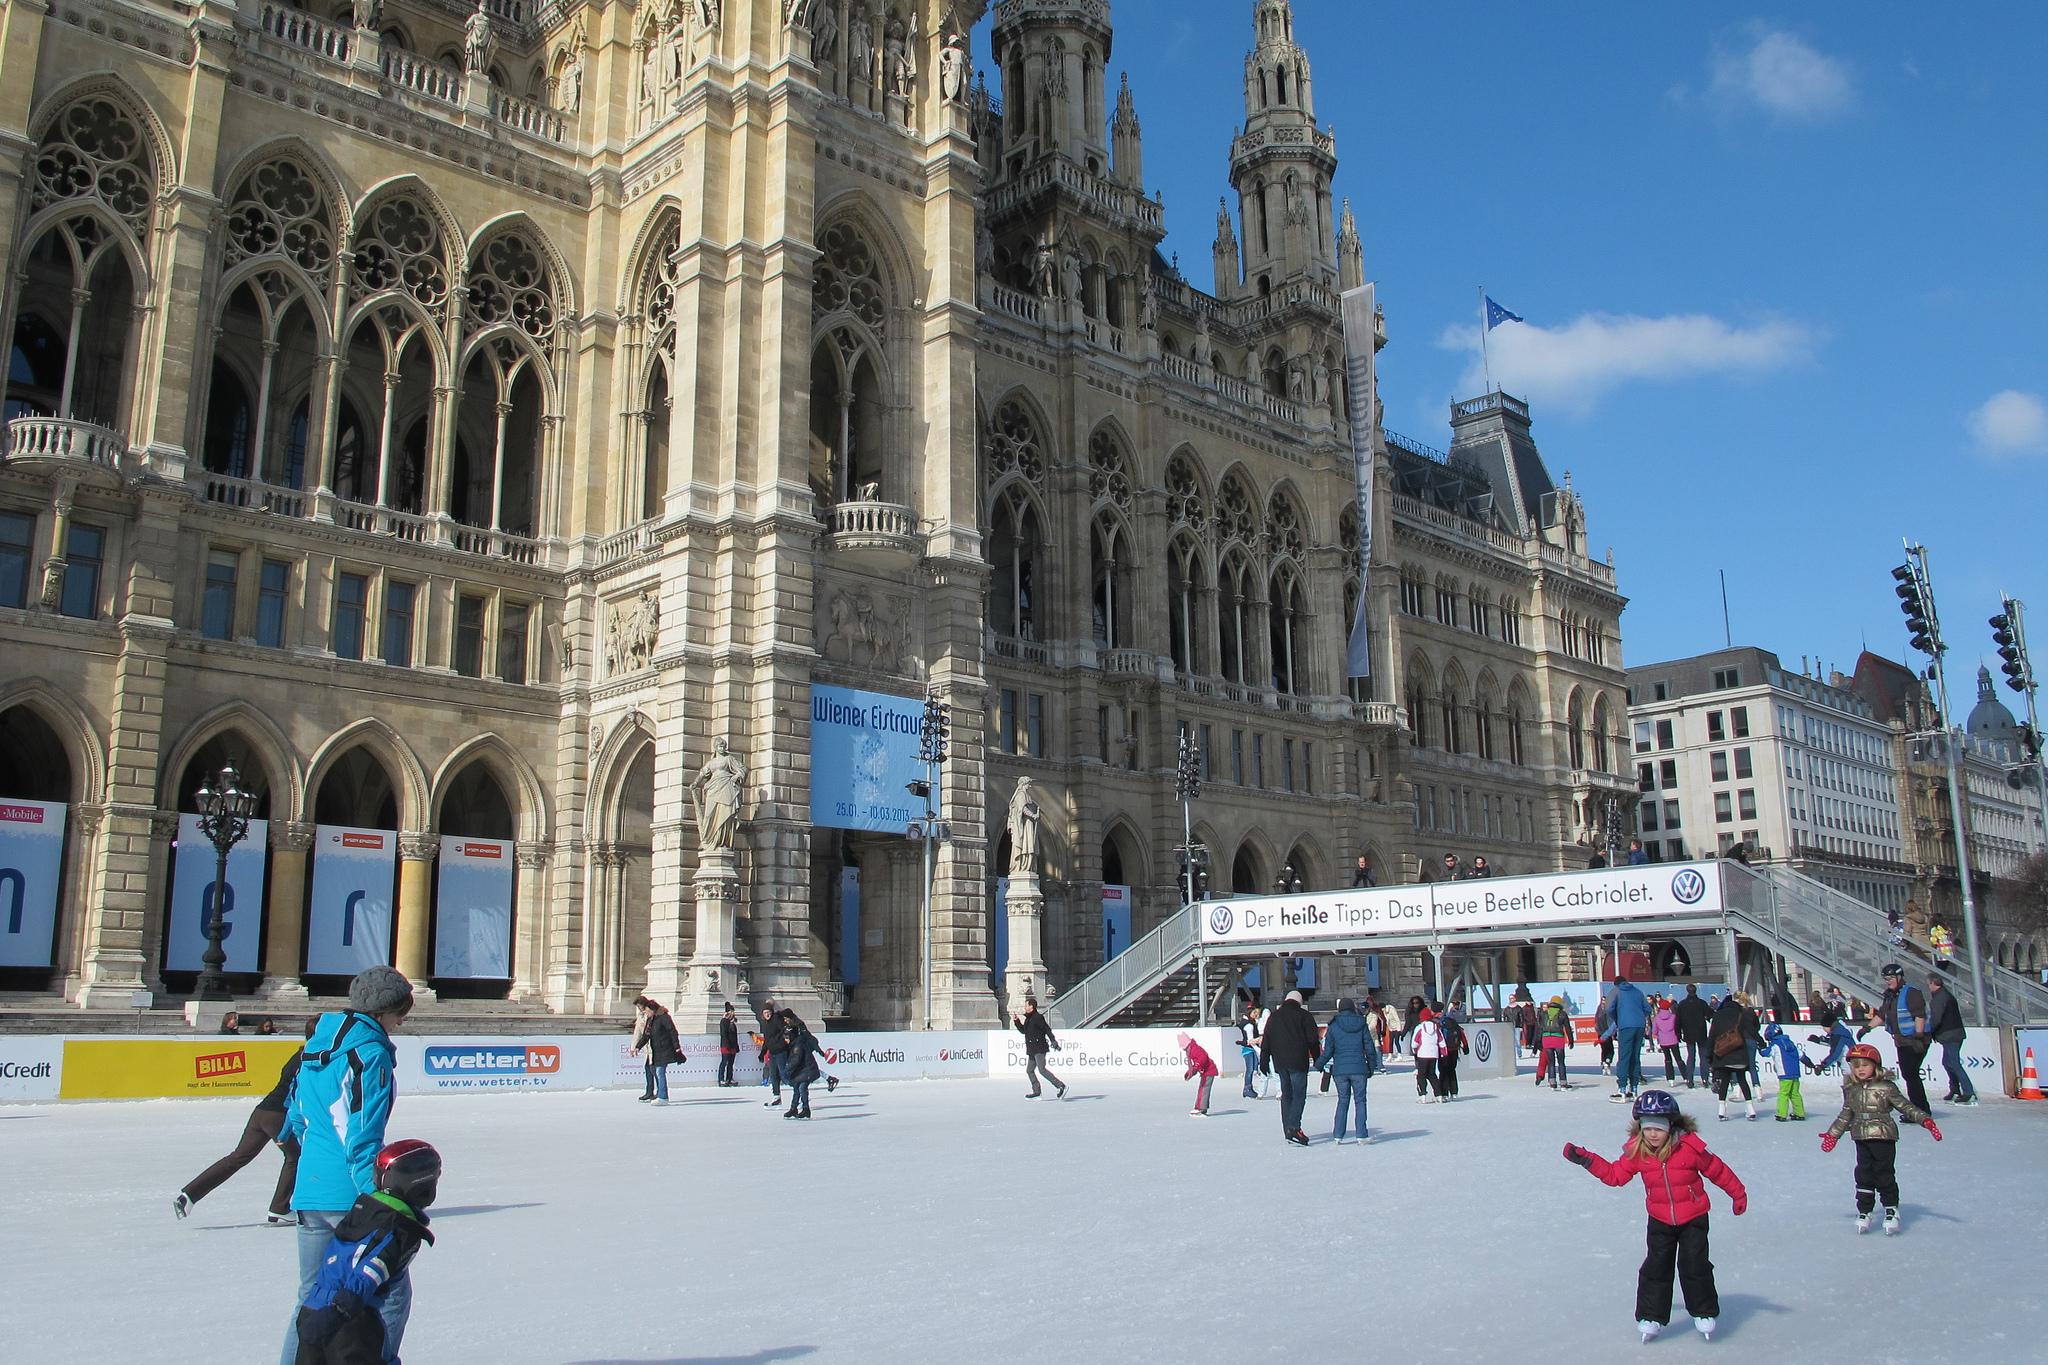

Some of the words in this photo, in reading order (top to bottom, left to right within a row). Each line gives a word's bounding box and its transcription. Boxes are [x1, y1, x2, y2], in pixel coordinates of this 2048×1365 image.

[813, 696, 867, 728] Wiener
[836, 802, 859, 818] 25.01.
[870, 806, 910, 822] 10.03.2013
[1245, 910, 1274, 928] Der
[1281, 904, 1329, 926] heiße
[1335, 903, 1379, 926] Tipp:
[1389, 899, 1424, 919] Das
[1434, 894, 1478, 916] neue
[1485, 887, 1545, 912] Beetle
[1551, 880, 1653, 906] Cabriolet.
[429, 1051, 558, 1069] wetter.tv
[838, 1048, 865, 1064] Bank
[868, 1048, 905, 1063] Austria
[949, 1048, 984, 1061] UniCredit
[1007, 1052, 1027, 1067] Da
[1048, 1056, 1074, 1067] eue
[1079, 1052, 1123, 1067] Beetle
[1128, 1052, 1189, 1067] Cabriole
[199, 1055, 243, 1075] BILLA
[438, 1077, 548, 1087] www.wetter.tv
